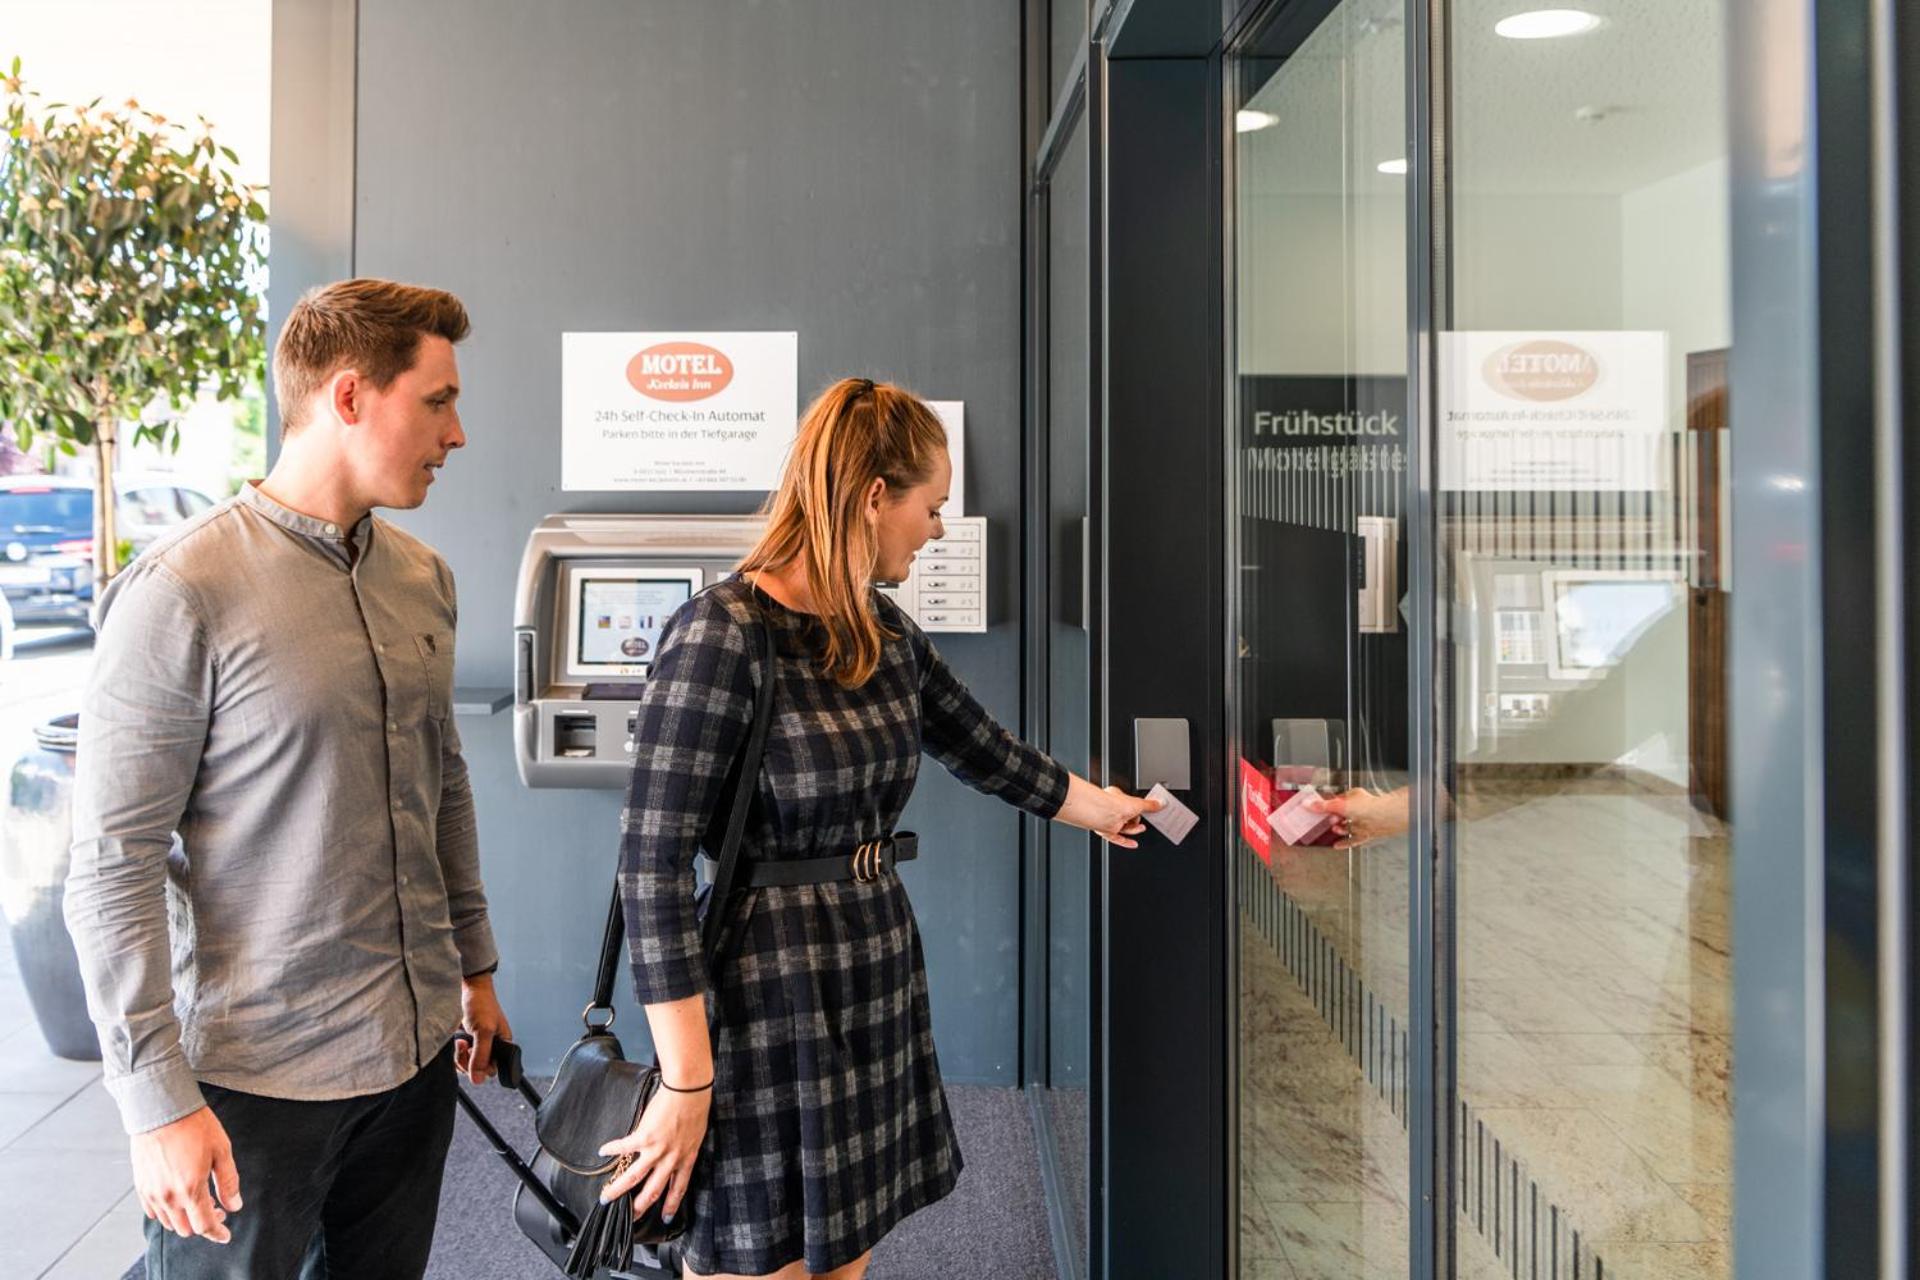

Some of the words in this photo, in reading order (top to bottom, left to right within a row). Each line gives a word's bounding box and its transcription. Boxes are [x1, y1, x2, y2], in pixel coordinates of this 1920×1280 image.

[641, 354, 723, 374] MOTEL
[595, 410, 618, 422] 24h
[621, 410, 705, 422] Self-Check-In
[708, 410, 766, 422] Automat
[1254, 409, 1399, 435] Frühstück
[603, 428, 639, 439] Parken
[641, 428, 666, 439] bitte
[668, 428, 678, 439] in
[680, 428, 697, 439] der
[701, 428, 758, 442] Tiefgarage
